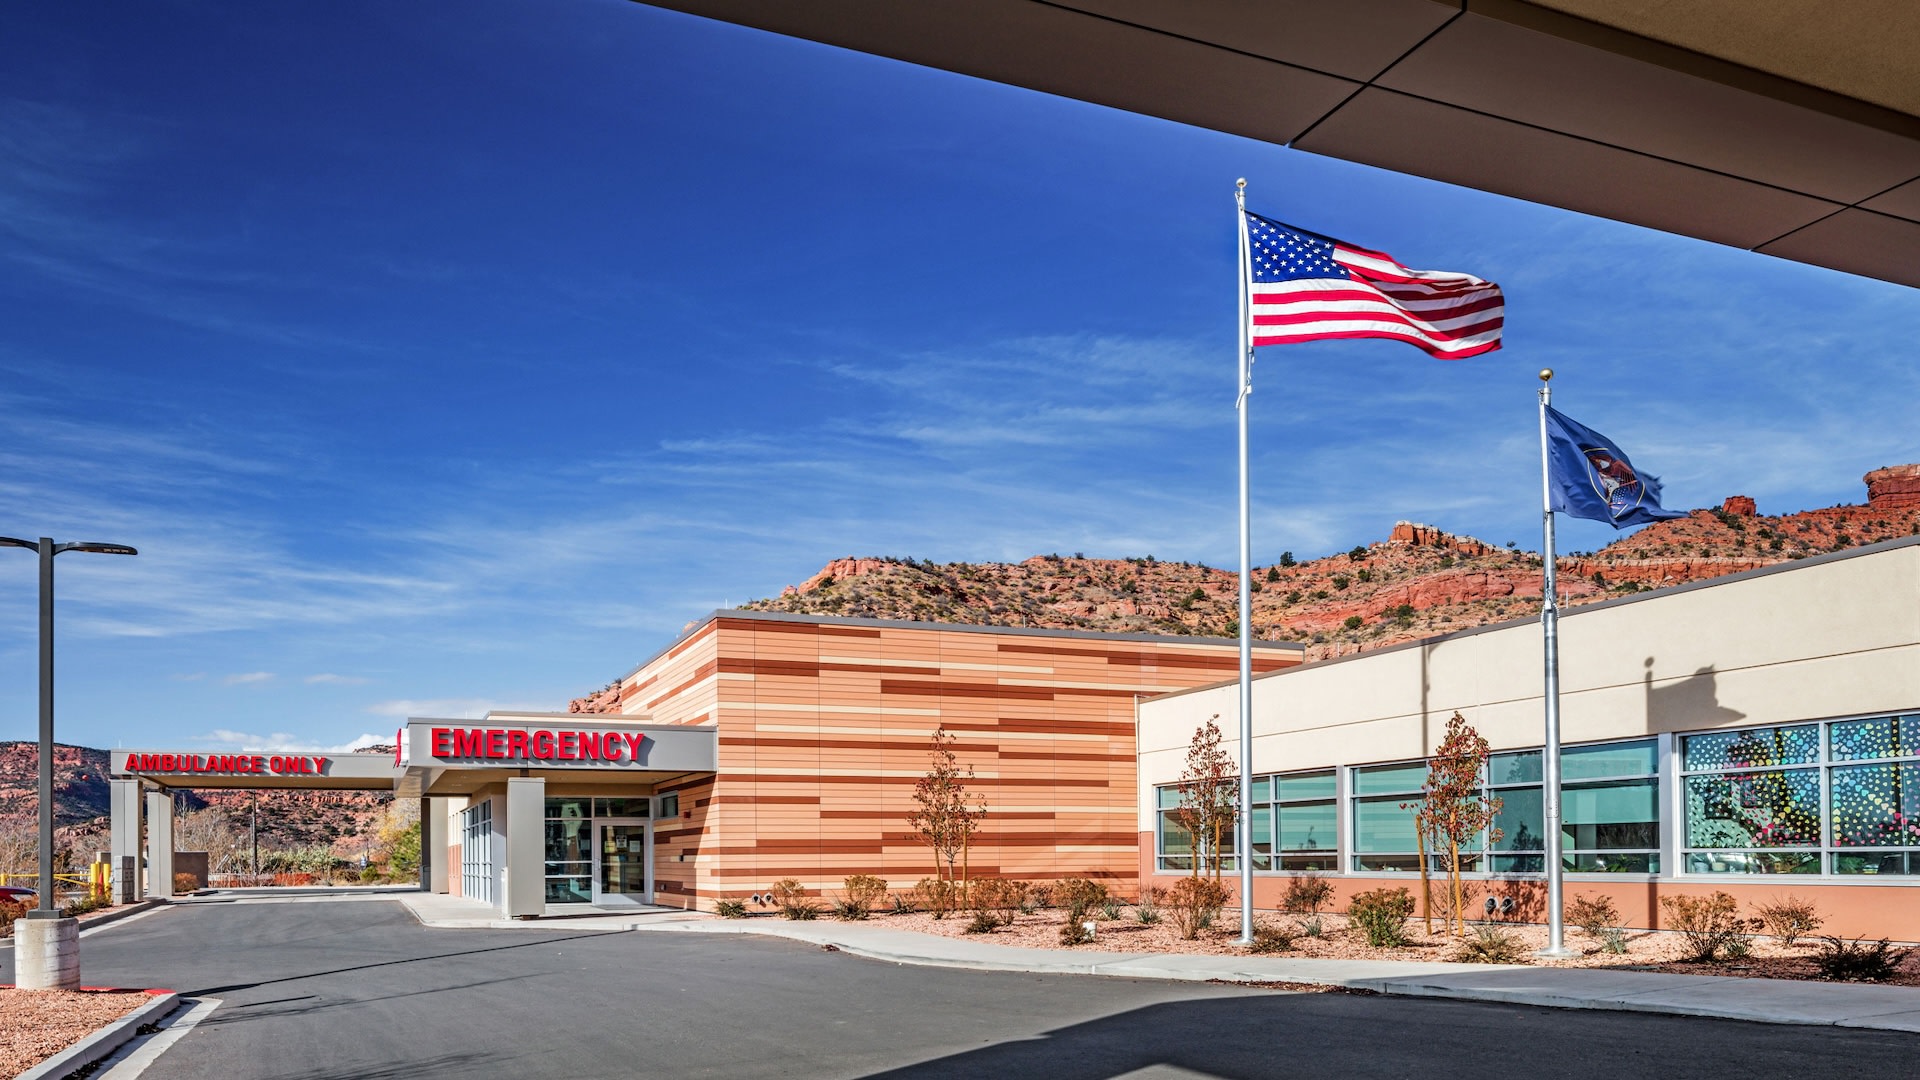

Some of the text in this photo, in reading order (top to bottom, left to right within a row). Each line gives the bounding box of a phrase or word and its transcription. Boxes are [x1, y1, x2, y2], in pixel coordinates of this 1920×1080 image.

[431, 727, 644, 762] EMERGENCY
[124, 753, 327, 775] AMBULANCE ONLY
